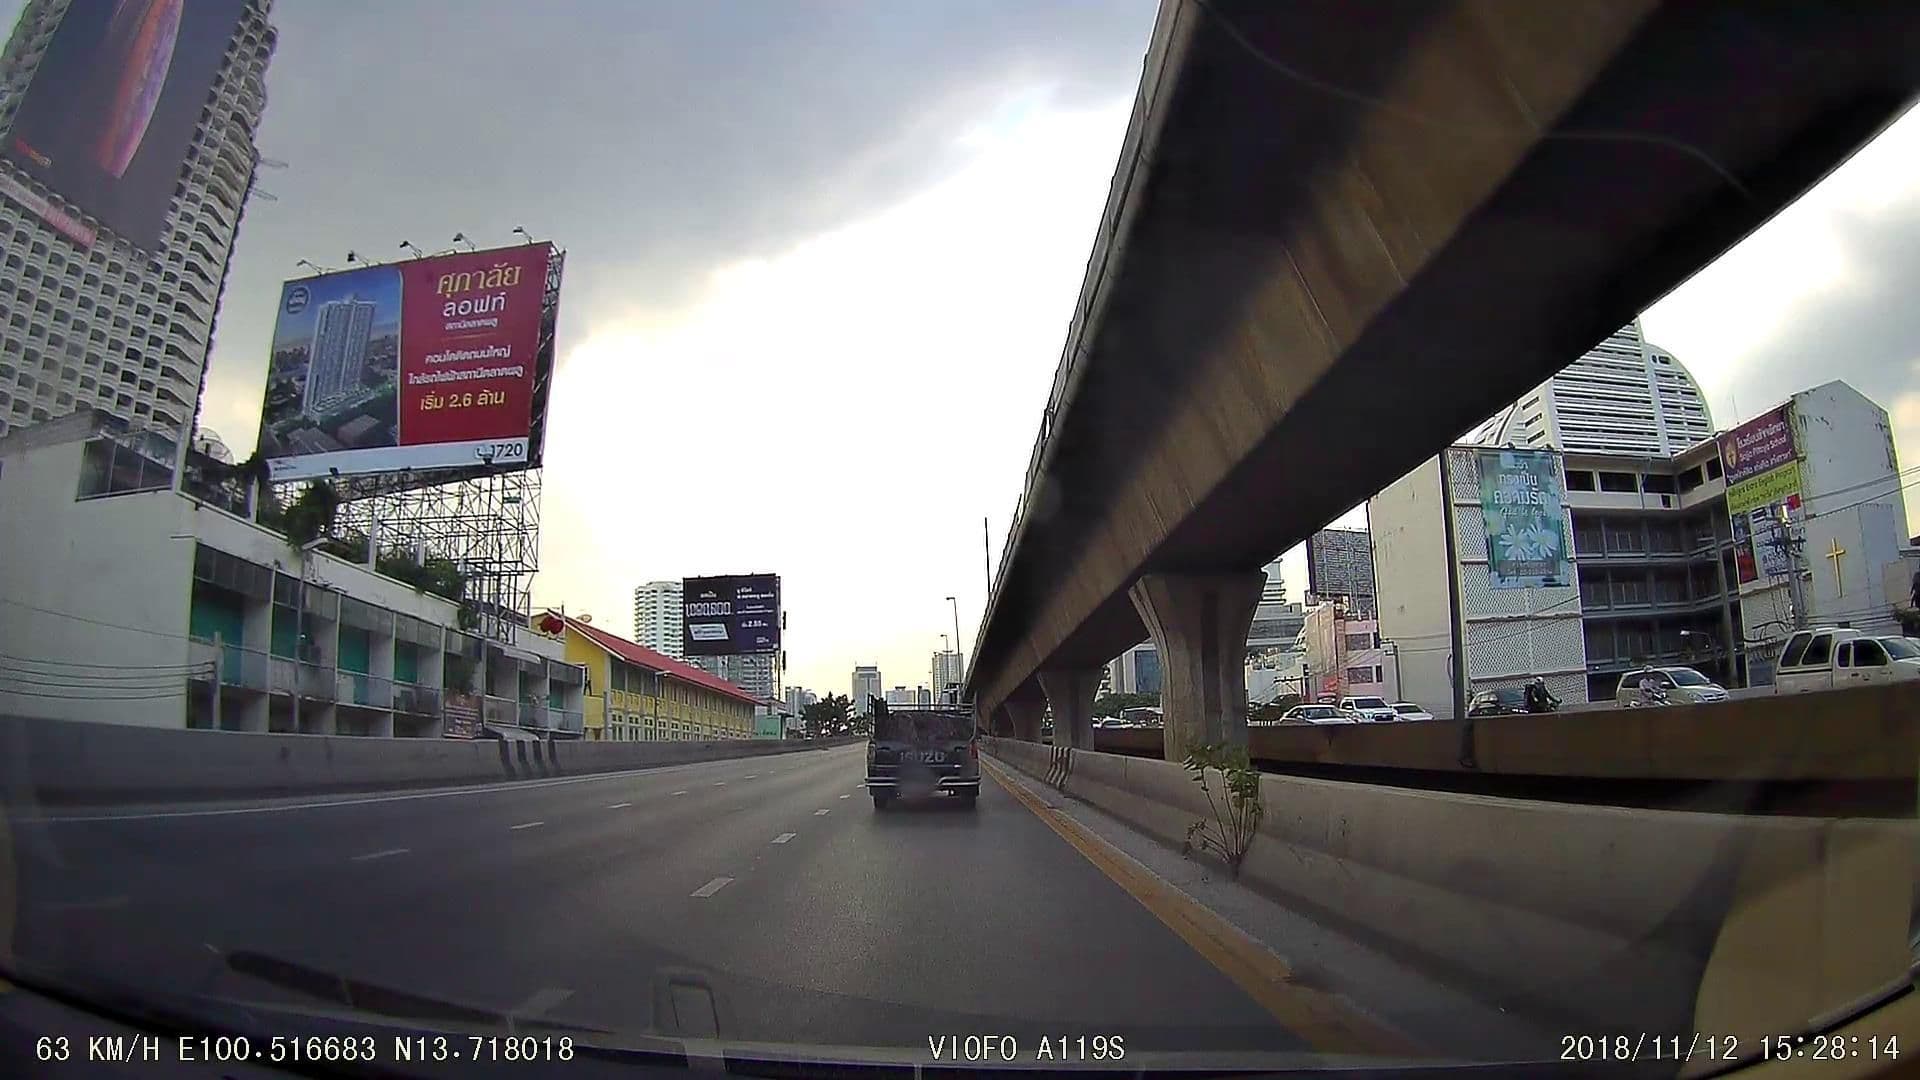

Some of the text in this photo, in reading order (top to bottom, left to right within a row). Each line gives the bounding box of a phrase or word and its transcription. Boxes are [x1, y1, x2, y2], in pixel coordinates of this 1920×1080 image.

[437, 262, 522, 298] ศุภาลัย
[443, 292, 507, 317] ลอฟท์
[420, 389, 506, 411] เริ่ม 2.6 ล้าน
